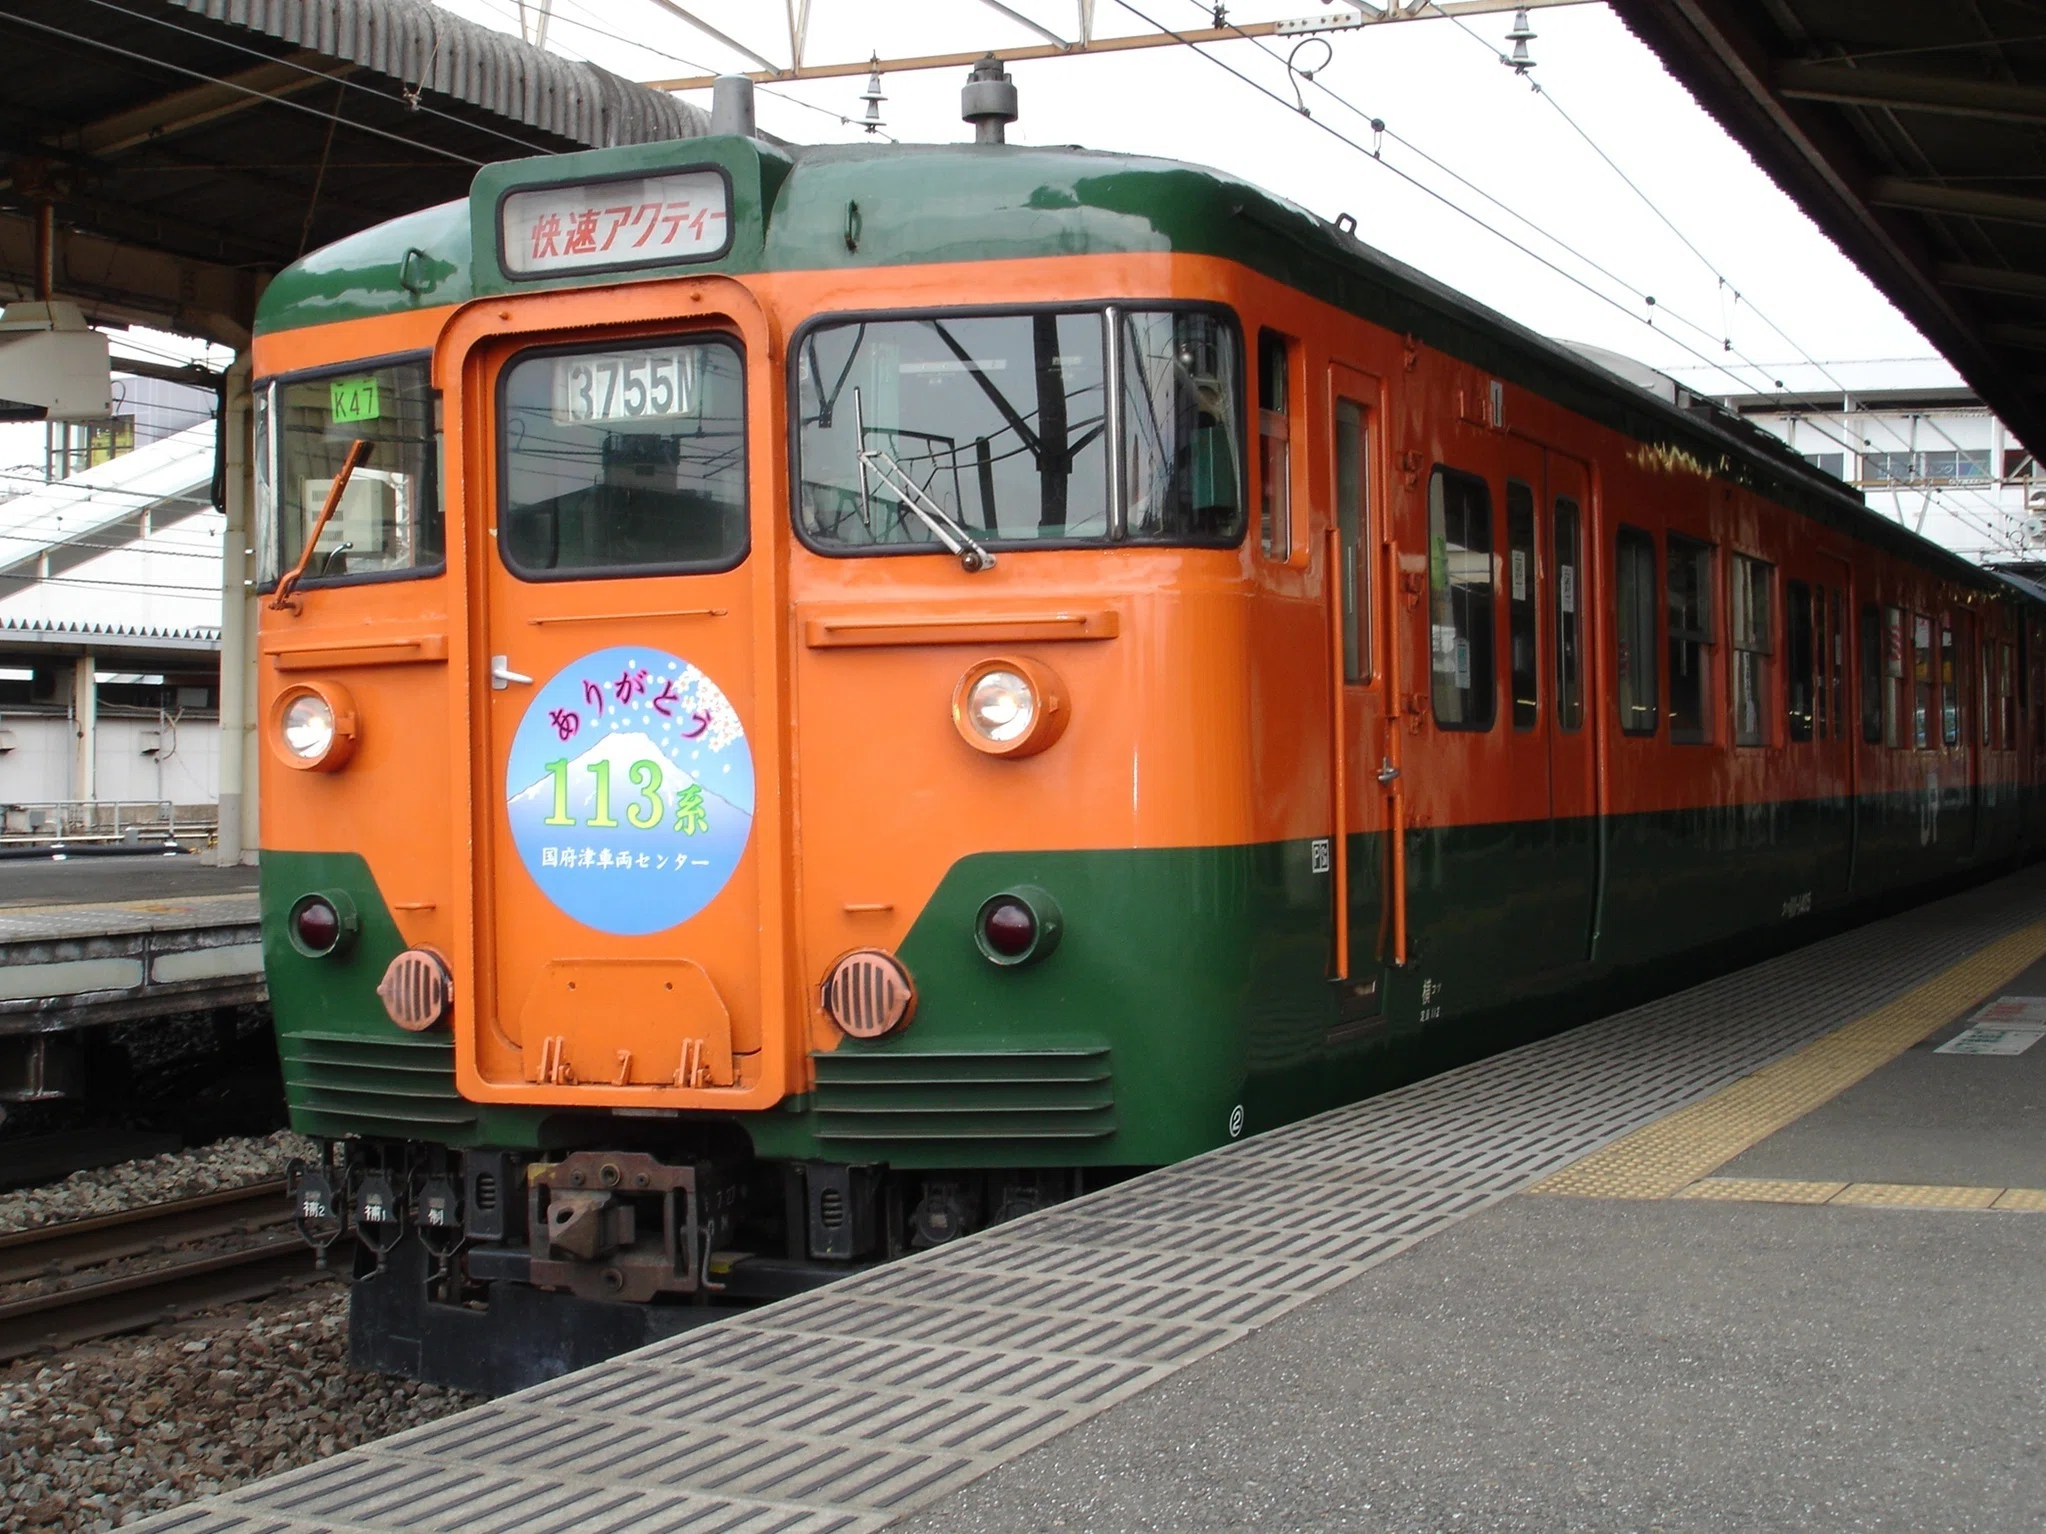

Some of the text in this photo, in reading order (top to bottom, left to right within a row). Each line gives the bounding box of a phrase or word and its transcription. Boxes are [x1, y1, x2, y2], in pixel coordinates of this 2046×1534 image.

[530, 202, 727, 259] 快速アクティー
[334, 387, 373, 418] K47
[548, 669, 711, 742] ありがとう
[543, 757, 709, 837] 113系
[541, 846, 709, 870] 国府津車両センター
